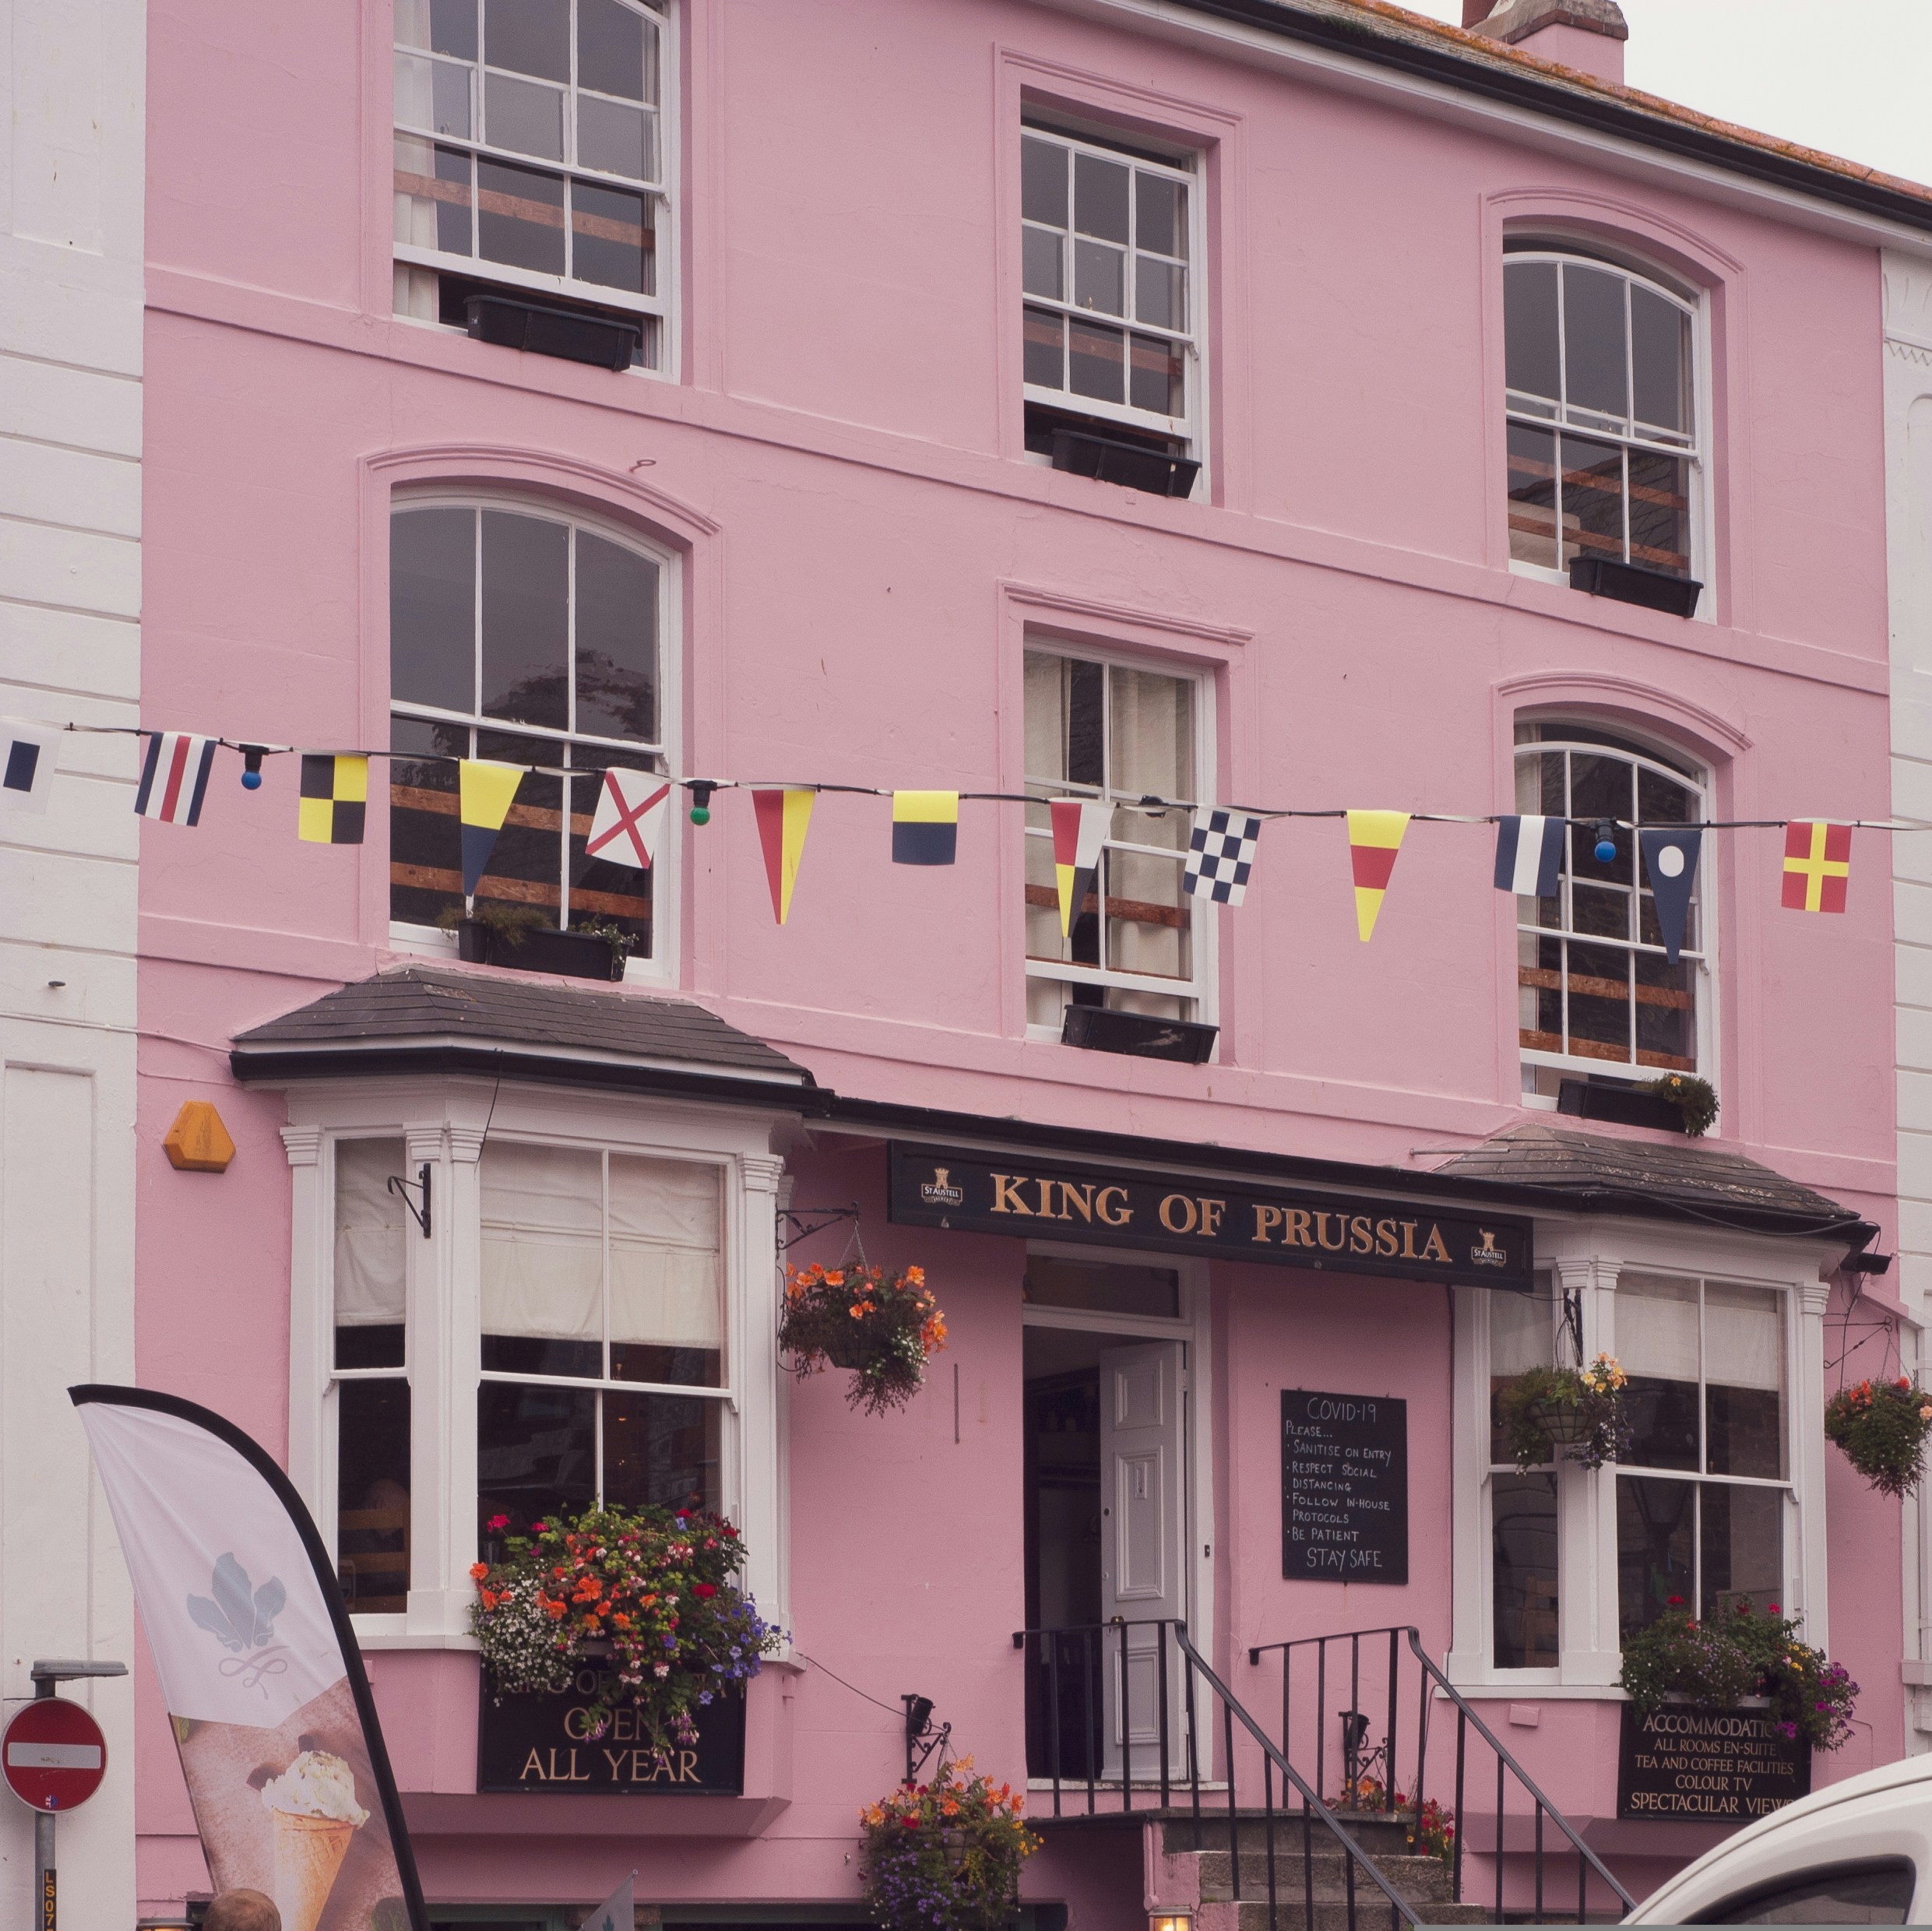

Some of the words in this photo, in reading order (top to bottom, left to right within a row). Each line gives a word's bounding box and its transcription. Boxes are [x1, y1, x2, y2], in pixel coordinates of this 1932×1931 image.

[933, 1188, 959, 1198] AUSTELL
[990, 1173, 1134, 1226] KING
[1159, 1194, 1226, 1236] OF
[1252, 1205, 1453, 1263] PRUSSIA
[1307, 1397, 1377, 1423] COVID-19
[1286, 1419, 1333, 1438] PLEASE...
[1293, 1439, 1341, 1457] SANITISE
[1345, 1447, 1359, 1458] ON
[1364, 1447, 1392, 1467] ENTRY
[1292, 1461, 1333, 1475] RESPECT
[1342, 1463, 1377, 1478] SOCIAL
[1293, 1478, 1352, 1493] DISTANCING
[1293, 1493, 1339, 1507] FOLLOW
[1346, 1497, 1390, 1511] IN-HOUSE
[1293, 1508, 1350, 1524] PROTOCOLS
[1292, 1527, 1305, 1541] BE
[1311, 1528, 1360, 1542] PATIENT
[1307, 1547, 1346, 1572] STAY
[1350, 1548, 1383, 1567] SAFE
[1654, 1738, 1676, 1752] ALL
[1680, 1739, 1720, 1753] ROOMS
[1724, 1741, 1776, 1757] EN-SUITE
[519, 1746, 590, 1781] ALL
[602, 1749, 703, 1783] YEAR
[1635, 1754, 1658, 1768] TEA
[1661, 1757, 1688, 1770] AND
[1691, 1757, 1733, 1772] COFFEE
[1737, 1760, 1794, 1775] FACILITIES
[1675, 1774, 1729, 1791] COLOUR
[1733, 1777, 1752, 1792] TV
[1631, 1792, 1740, 1813] SPECTACULAR
[1746, 1796, 1794, 1814] VIEW
